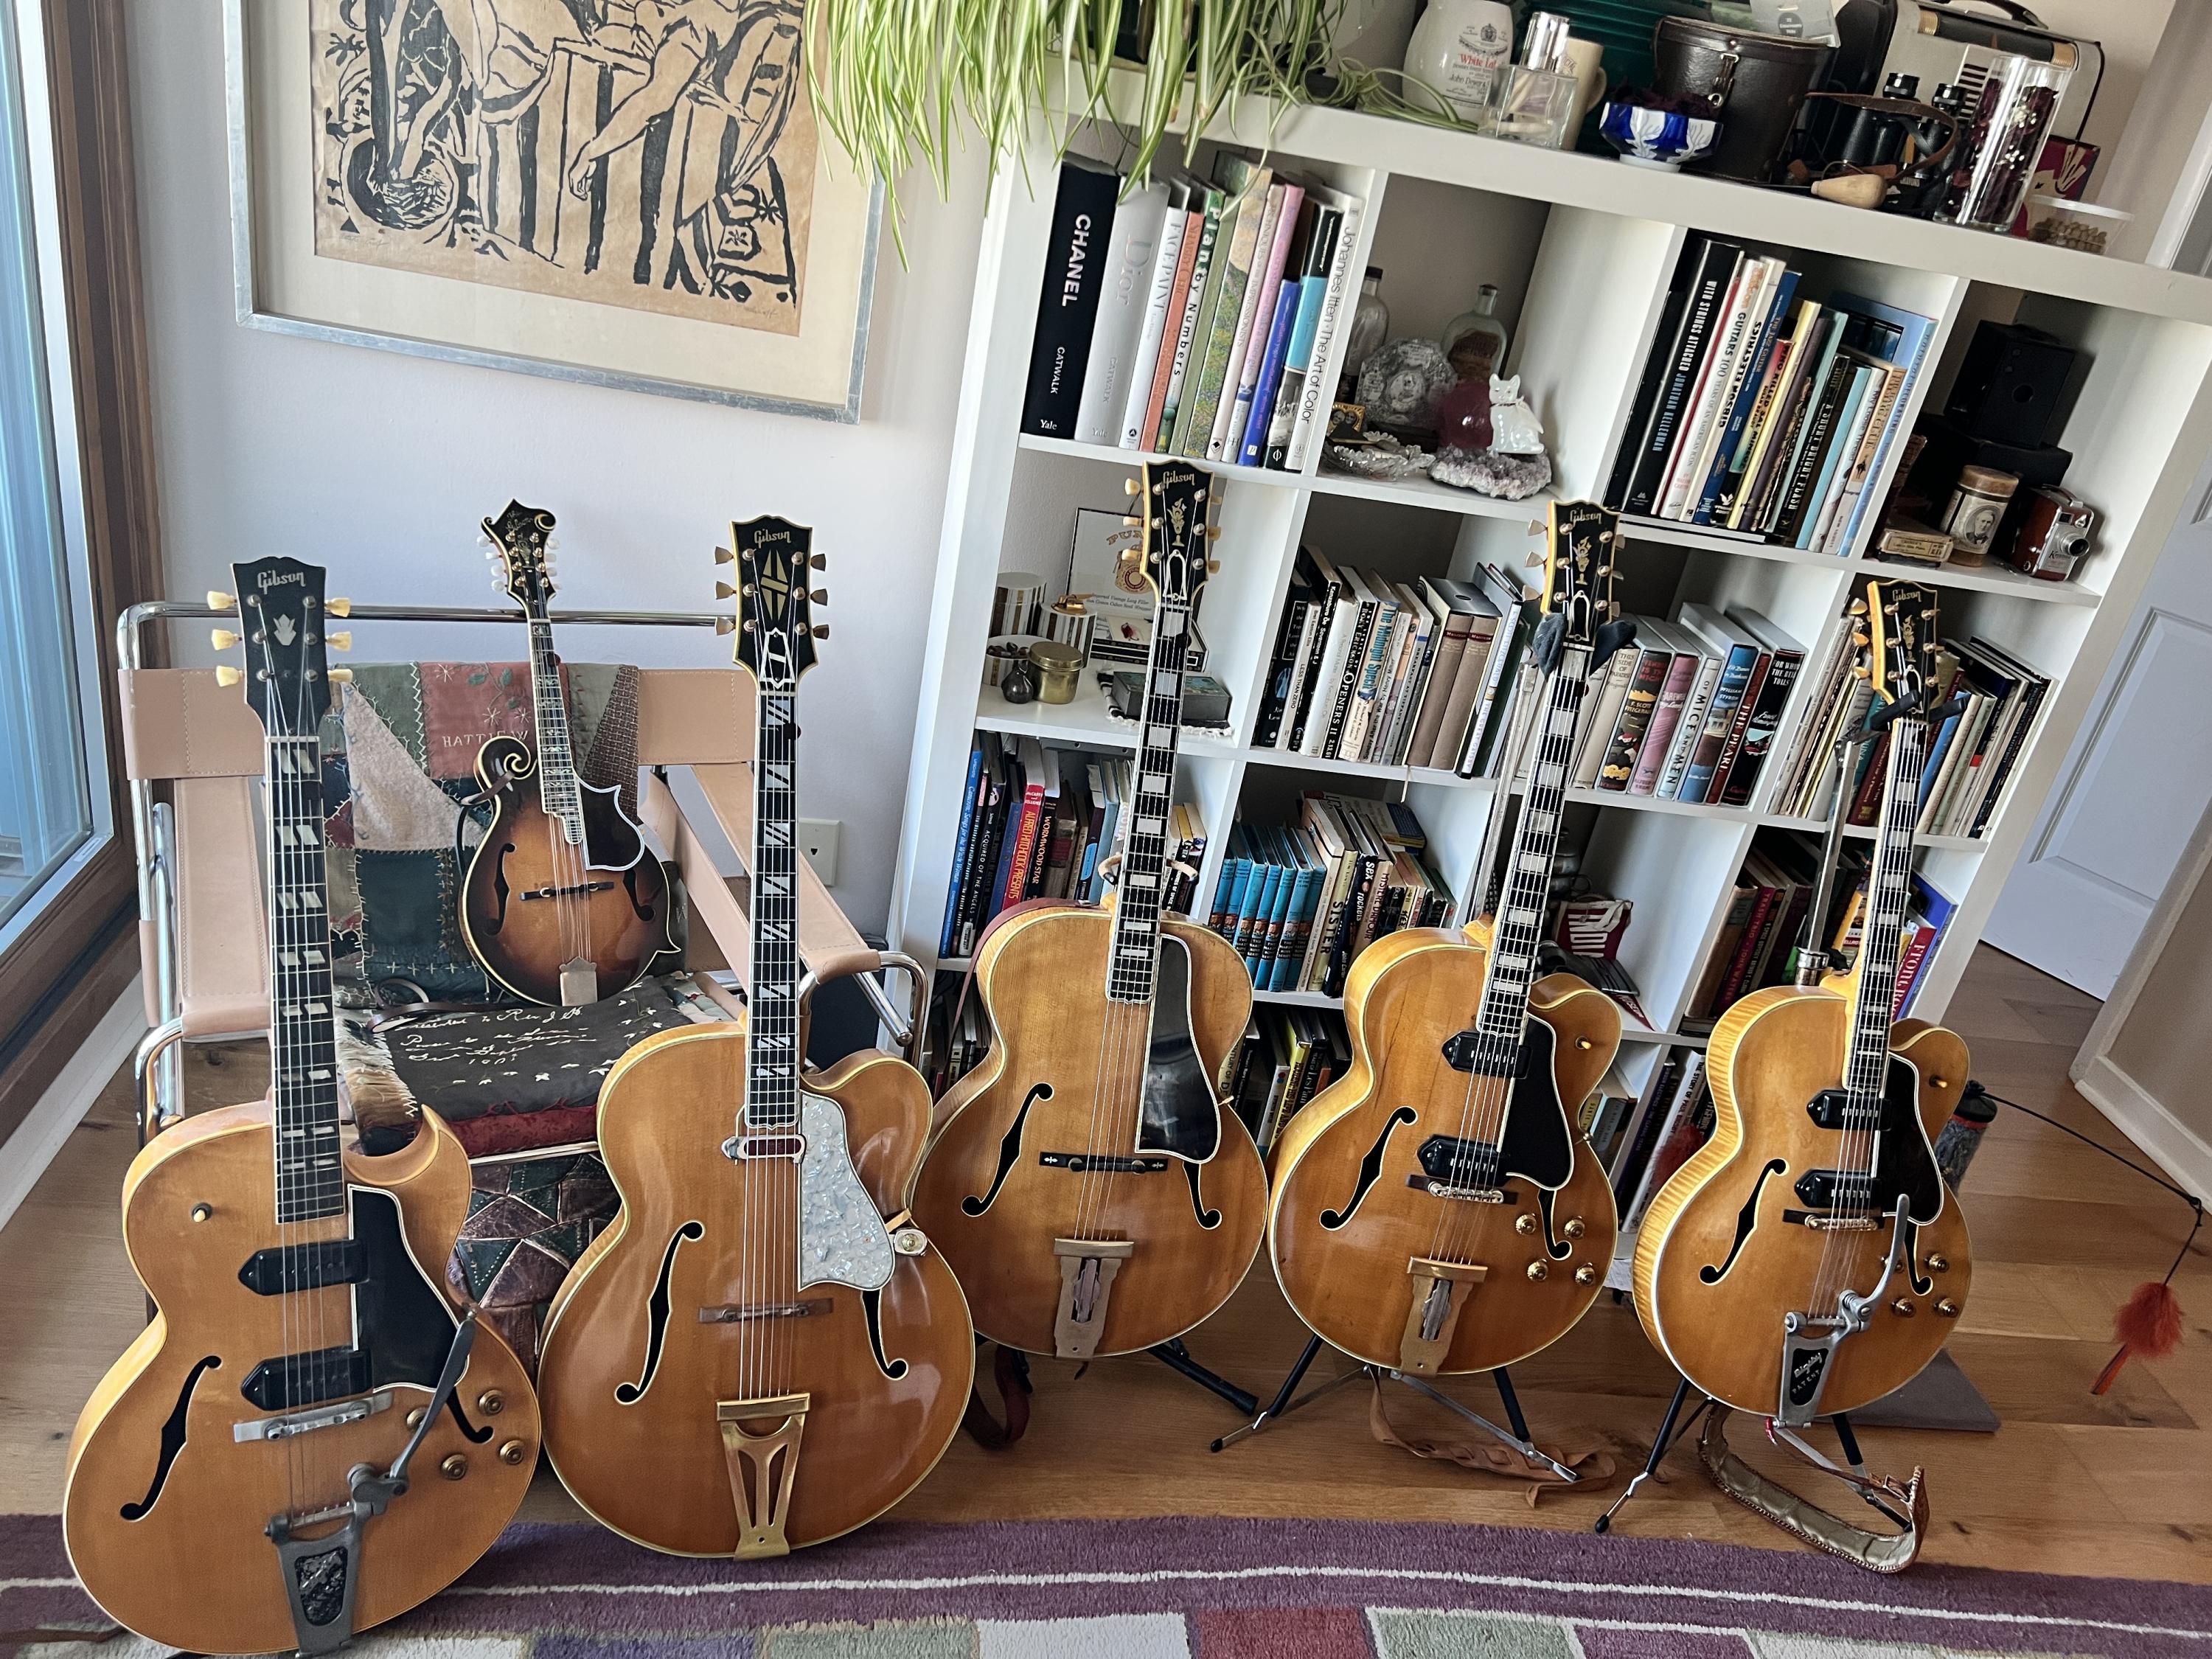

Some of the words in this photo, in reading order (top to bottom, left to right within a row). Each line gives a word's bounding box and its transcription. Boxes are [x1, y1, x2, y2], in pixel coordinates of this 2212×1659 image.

[1460, 54, 1484, 67] White
[1162, 222, 1181, 262] FACE
[1180, 223, 1199, 266] SHABBY
[1061, 212, 1091, 307] CHANEL
[1113, 233, 1154, 306] Dior
[1330, 226, 1355, 294] Johannes
[1152, 265, 1172, 310] PAINT
[1173, 268, 1189, 299] CHIC
[1190, 274, 1204, 293] by
[1701, 279, 1717, 302] WITH
[1236, 279, 1258, 347] IMPRESSIONISTS
[1324, 295, 1340, 324] Itten
[1690, 299, 1710, 335] STRINGS
[1173, 302, 1197, 376] Numbers
[1317, 329, 1332, 354] The
[1724, 311, 1747, 357] GUITARS
[1312, 355, 1326, 375] Art
[1678, 334, 1698, 372] ATTACHED
[1776, 344, 1790, 371] WHO
[1050, 346, 1065, 394] CATWALK
[1102, 356, 1116, 403] CATWALK
[1716, 358, 1730, 377] 100
[1717, 383, 1739, 428] GIBSON
[1733, 319, 1762, 383] ELECTRICS
[1309, 375, 1321, 387] of
[1666, 372, 1686, 411] JONATHAN
[1763, 372, 1780, 407] KILLED
[1301, 389, 1318, 423] Color
[1860, 406, 1873, 431] Loose
[1040, 419, 1057, 431] Yale
[1652, 409, 1674, 453] KELLERMAN
[1755, 410, 1765, 429] SAL
[1814, 412, 1830, 442] SHORT
[1848, 433, 1863, 462] Thread
[1800, 445, 1818, 479] BRIGHT
[1163, 470, 1195, 489] Gibson
[1788, 481, 1805, 512] FLASH
[1570, 507, 1601, 526] Gibson
[754, 529, 791, 549] Gibson
[257, 570, 306, 594] Gibson
[1324, 585, 1336, 616] Kenzaburo
[1892, 589, 1921, 603] Gibson
[1381, 608, 1396, 625] The
[1314, 627, 1326, 654] Seventeen
[1345, 630, 1361, 669] ERICKSON
[1367, 624, 1392, 664] Midnight
[1408, 647, 1421, 683] BREAKFAST
[1772, 668, 1783, 677] THE
[1783, 669, 1797, 678] BELL
[1381, 675, 1393, 692] Henry
[1703, 681, 1710, 689] OF
[1773, 677, 1791, 686] TOLLS
[1331, 671, 1355, 725] OPENERS
[1374, 701, 1382, 713] War
[1396, 694, 1407, 725] TIFFANY'S
[1482, 702, 1490, 714] THE
[1371, 713, 1380, 723] the
[1686, 693, 1706, 732] MICE
[1733, 701, 1750, 730] THE
[1329, 726, 1337, 735] II
[1368, 723, 1377, 738] After
[1475, 717, 1485, 738] GREAT
[1362, 738, 1374, 759] Sunday
[1466, 742, 1478, 767] GATSBY
[1680, 734, 1690, 751] AND
[1666, 752, 1684, 785] MEN
[965, 786, 975, 812] Cameron:
[961, 813, 970, 828] Songs
[1021, 810, 1035, 833] ALFRED
[979, 830, 990, 863] ACQUIRED
[1015, 832, 1031, 869] HITCHCOCK
[1035, 815, 1051, 865] WORMWOOD
[953, 863, 962, 883] Woman
[977, 864, 984, 873] OF
[1032, 866, 1040, 884] STAR
[1364, 861, 1374, 880] sex
[1008, 868, 1023, 900] PRESENTS
[970, 890, 978, 914] ANGELS
[1355, 891, 1364, 921] rockets
[1756, 891, 1770, 919] TRASH
[1320, 900, 1343, 955] SISTER
[1747, 920, 1759, 939] TRIO
[1736, 948, 1748, 969] JOHN
[1896, 942, 1925, 989] Front
[1724, 970, 1739, 1001] WATERS
[1224, 1070, 1231, 1079] OF
[1304, 1071, 1316, 1086] Les
[1695, 1061, 1704, 1072] THE
[1688, 1072, 1699, 1090] STORY
[1299, 1085, 1313, 1105] Paul
[1678, 1098, 1688, 1113] PAUL
[1685, 1090, 1691, 1098] OF
[1792, 1369, 1820, 1394] PATENT
